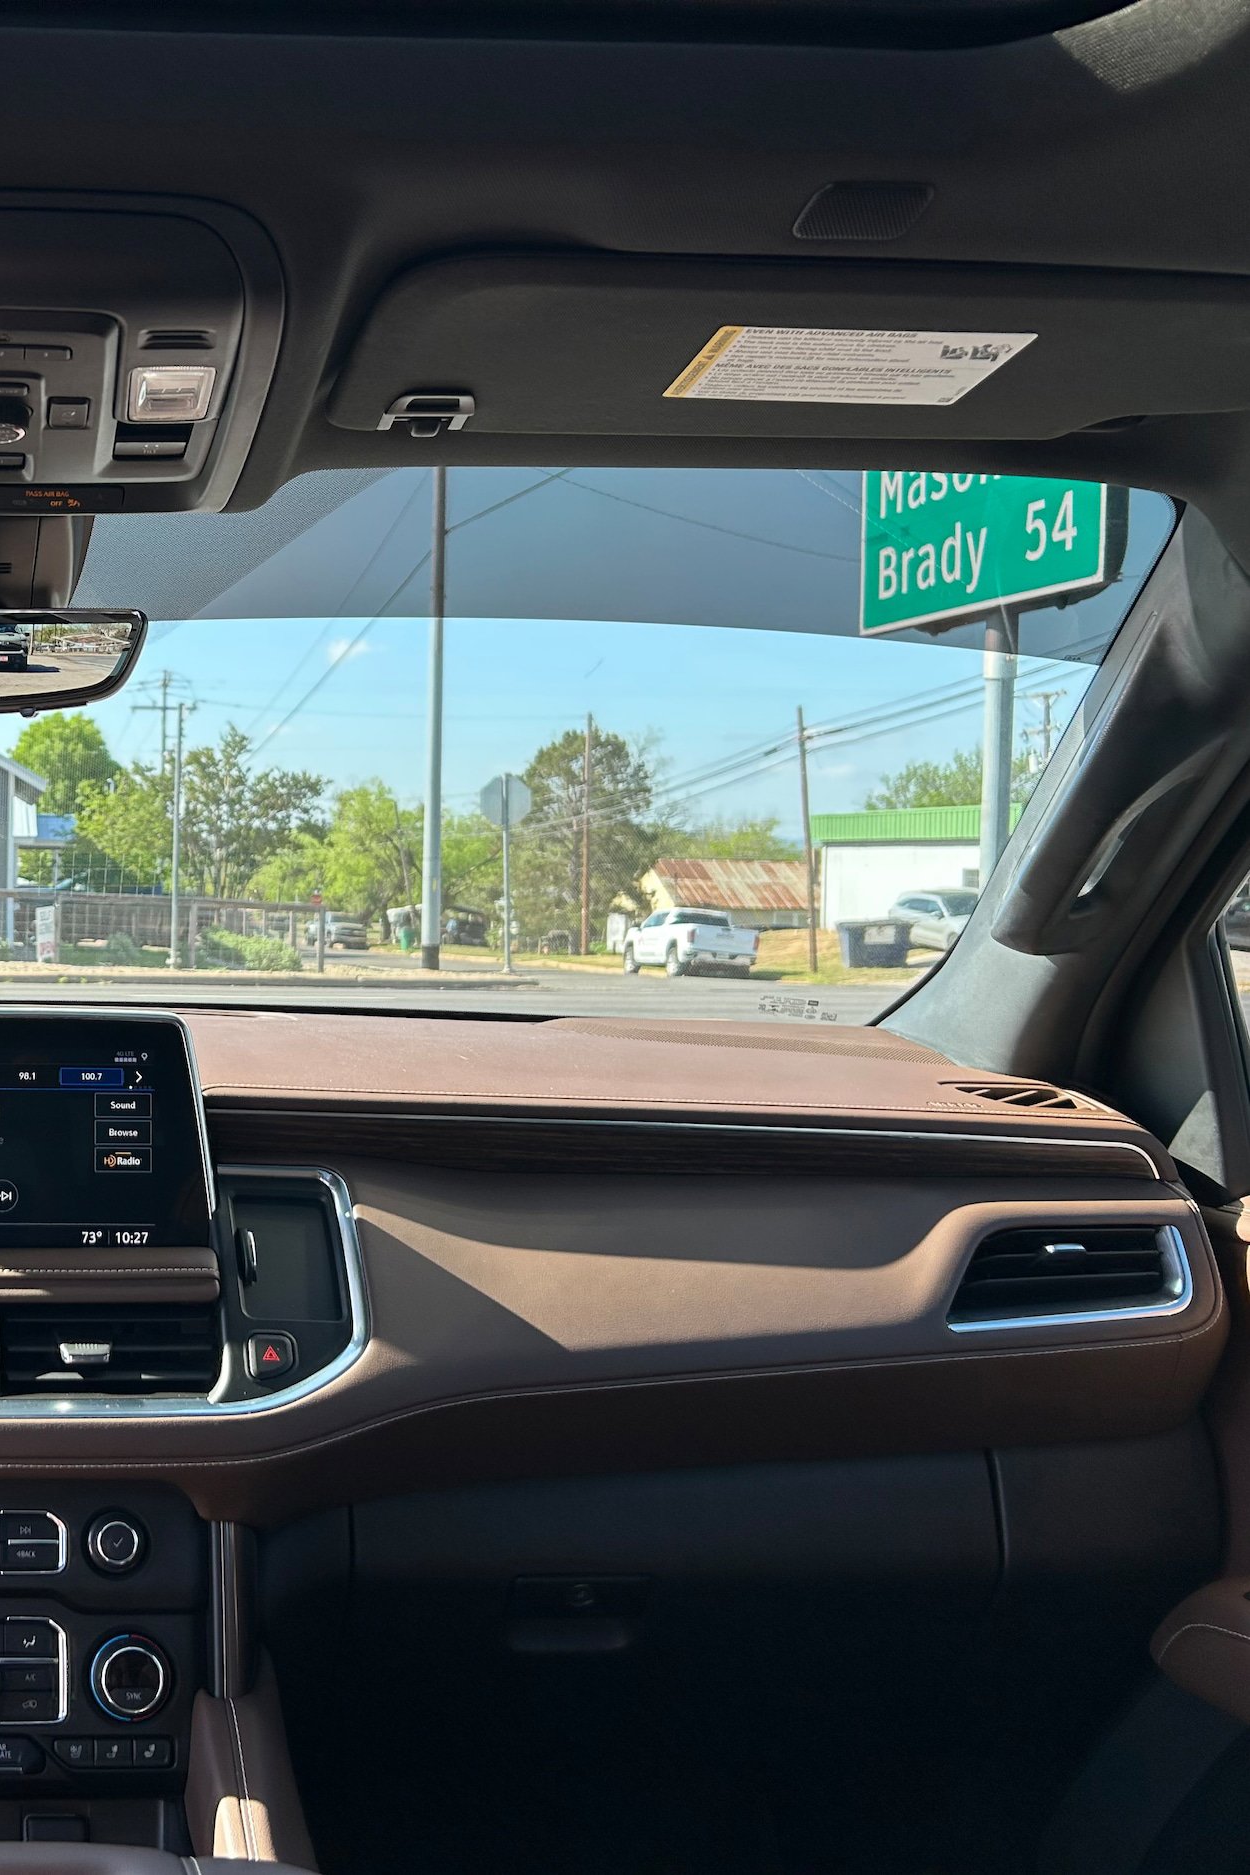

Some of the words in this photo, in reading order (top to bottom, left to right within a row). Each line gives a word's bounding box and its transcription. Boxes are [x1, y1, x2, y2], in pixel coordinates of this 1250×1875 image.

[25, 490, 43, 498] PASS
[879, 471, 1001, 519] Maso
[878, 521, 988, 600] Brady
[1025, 489, 1078, 562] 54
[18, 1071, 37, 1081] 98.1
[81, 1072, 103, 1081] 100.7
[110, 1101, 136, 1110] Sound
[108, 1128, 139, 1137] Browse
[116, 1156, 141, 1166] Radio
[115, 1231, 149, 1245] 10:27
[21, 1550, 36, 1558] BACK
[24, 1673, 37, 1682] A/C
[125, 1691, 142, 1701] SYNC
